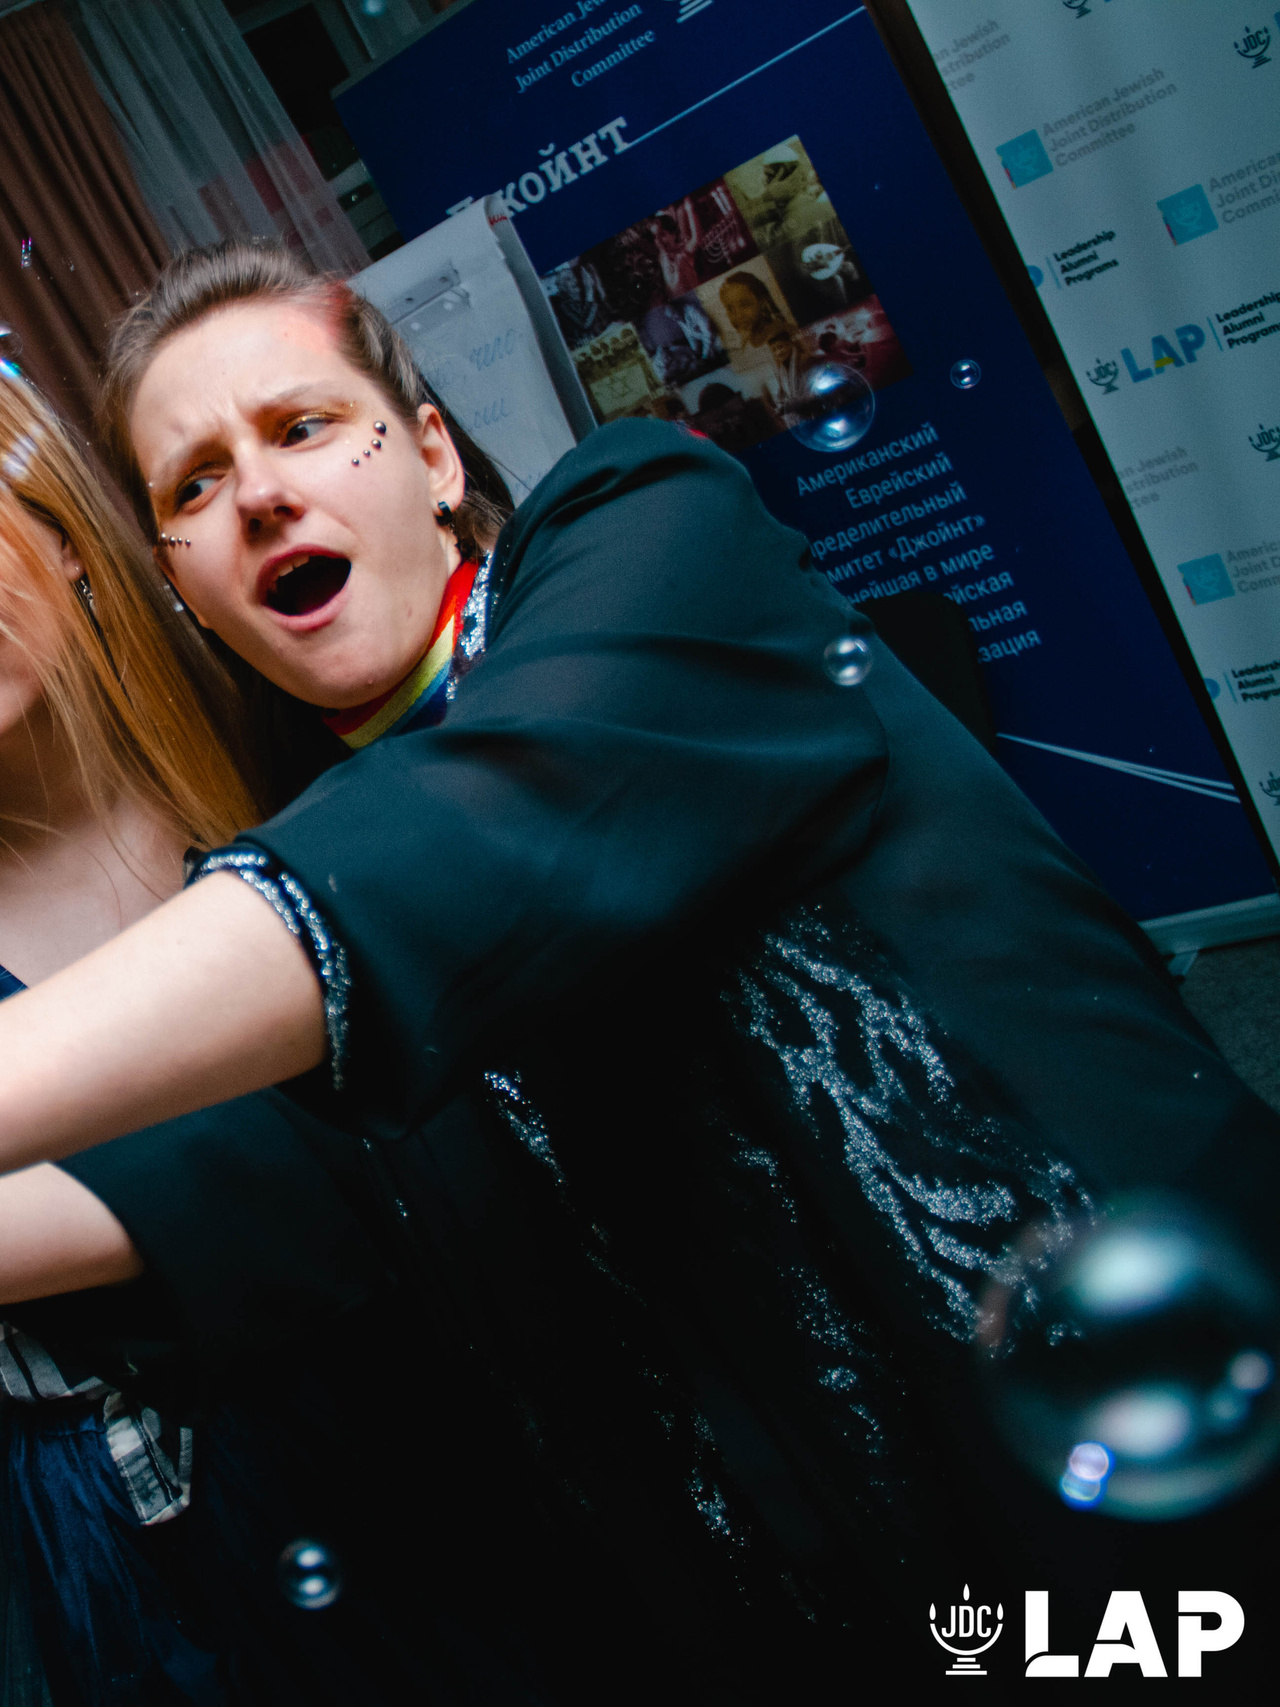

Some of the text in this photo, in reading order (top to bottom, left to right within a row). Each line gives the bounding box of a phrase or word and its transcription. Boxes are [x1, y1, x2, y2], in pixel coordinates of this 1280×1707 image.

[506, 11, 577, 64] American
[515, 4, 643, 94] Joint Distribution
[951, 18, 999, 54] Jewish
[1242, 30, 1266, 54] JDC
[570, 29, 656, 87] Committee
[1043, 67, 1165, 136] American Jewish
[1049, 83, 1177, 151] Joint Distribution
[1055, 122, 1136, 167] Committee
[1217, 182, 1257, 208] Joint
[1222, 189, 1280, 224] Commi
[1053, 230, 1116, 262] Leadership
[1060, 252, 1099, 274] Alumni
[1064, 259, 1119, 287] Programs
[1223, 311, 1266, 336] Alumni
[1227, 322, 1280, 349] Program
[1121, 324, 1206, 384] LAP
[1256, 428, 1277, 448] JDC
[796, 422, 939, 496] Американский
[1138, 446, 1187, 473] Jewish
[845, 451, 953, 509] Еврейский
[826, 514, 986, 584] митет «Джойнт»
[926, 564, 939, 582] в
[940, 543, 995, 576] мире
[1227, 540, 1280, 563] Americ
[1233, 560, 1269, 579] Joint
[1238, 674, 1276, 690] Alumni
